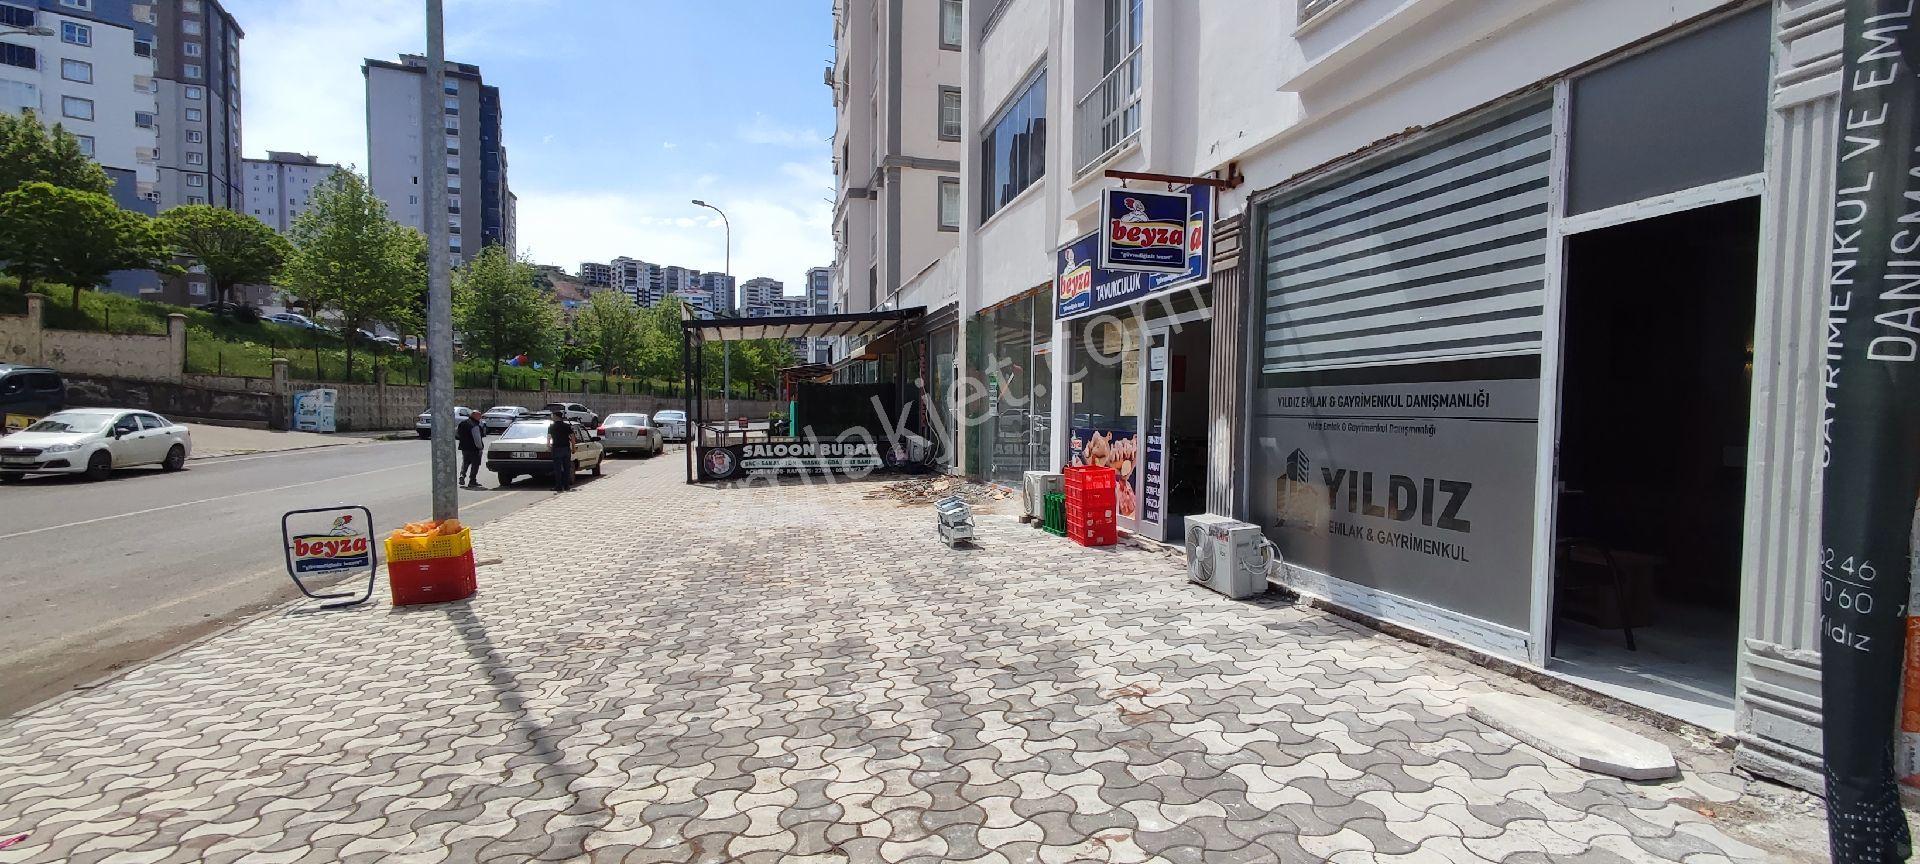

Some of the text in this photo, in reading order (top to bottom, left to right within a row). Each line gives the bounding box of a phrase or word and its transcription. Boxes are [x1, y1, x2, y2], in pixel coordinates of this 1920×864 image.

[1842, 102, 1889, 162] VE
[1111, 220, 1183, 248] beyza
[1060, 269, 1091, 297] beyza
[1277, 389, 1490, 411] YILDIZ EMLAK & GAYRİMENKUL DANIŞMANLIĞI
[742, 443, 878, 458] SALOON BURAK
[1321, 467, 1472, 534] YILDIZ
[293, 537, 367, 558] beyza
[1328, 520, 1470, 563] EMLAK & GAYRİMENKUL
[1840, 556, 1877, 581] 46
[1838, 588, 1874, 614] 60
